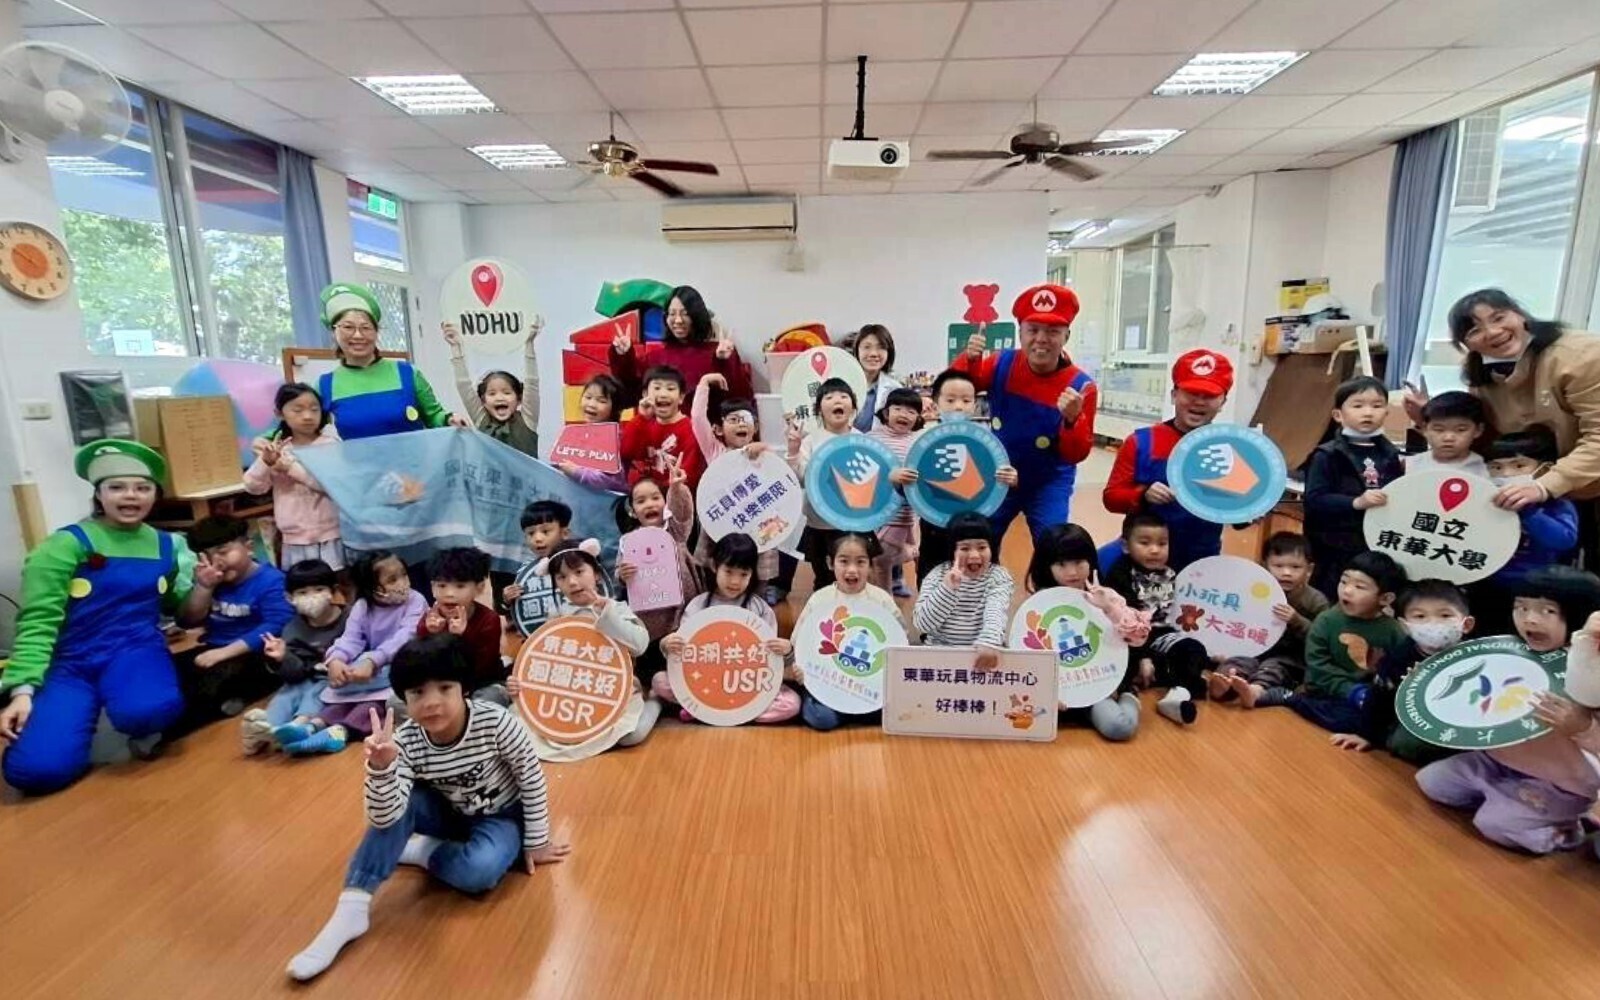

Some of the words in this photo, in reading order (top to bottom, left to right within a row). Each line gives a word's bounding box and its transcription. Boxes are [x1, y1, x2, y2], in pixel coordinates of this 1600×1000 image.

[460, 312, 520, 335] NDHU
[556, 446, 586, 458] LET'S
[588, 450, 616, 462] PLAY
[706, 473, 762, 521] 玩具傳愛
[1411, 511, 1469, 540] 國立
[1376, 530, 1488, 570] 東華大學
[1179, 583, 1240, 612] 小玩具
[542, 635, 615, 664] 東華大學
[723, 667, 773, 694] USR
[903, 667, 1038, 686] 東華玩具物流中心
[537, 693, 596, 727] USR
